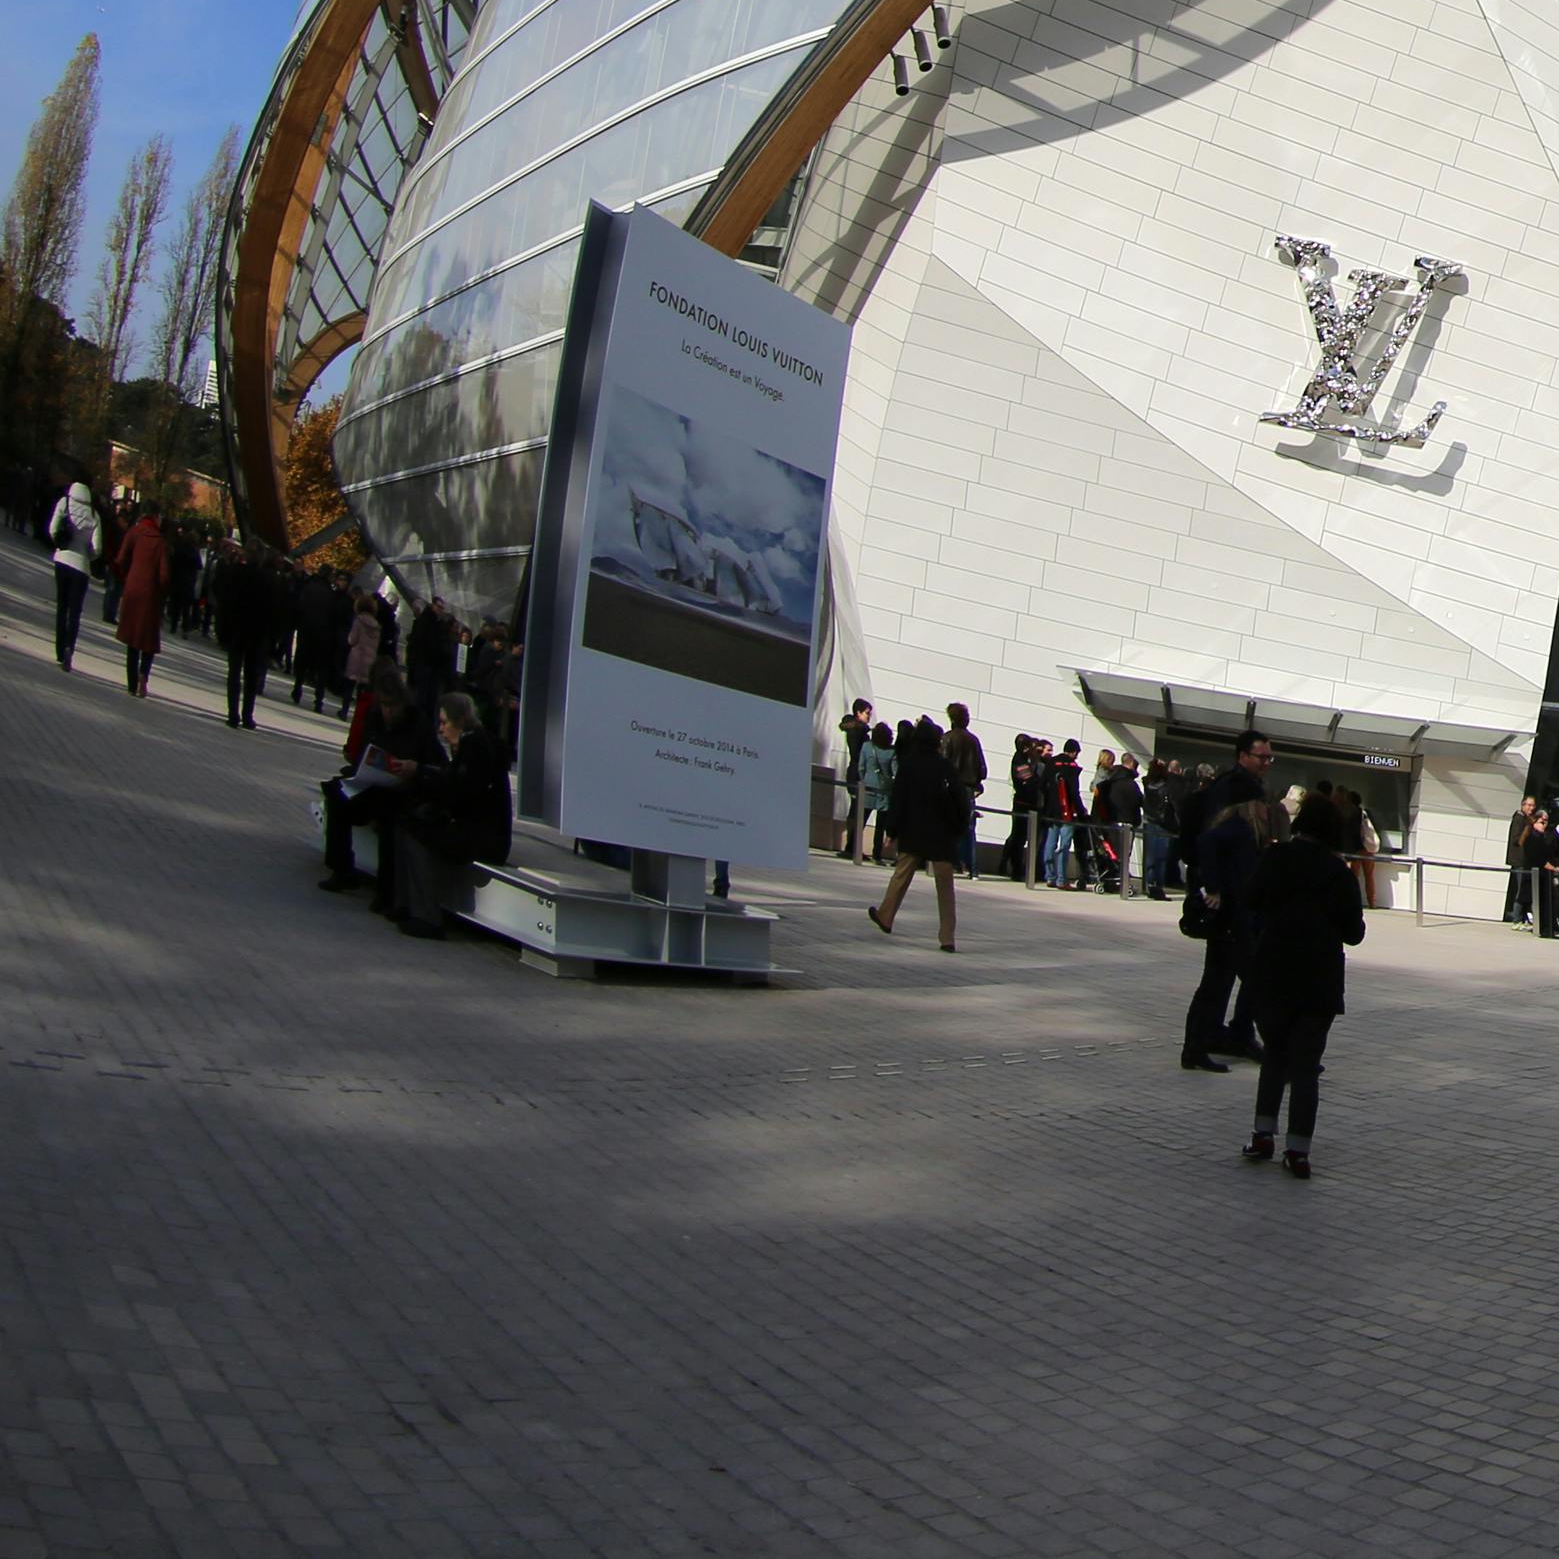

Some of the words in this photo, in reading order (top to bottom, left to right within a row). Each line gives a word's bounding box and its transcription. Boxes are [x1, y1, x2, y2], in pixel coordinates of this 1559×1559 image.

[649, 281, 728, 337] FONDATION
[732, 327, 769, 358] LOUIS
[773, 347, 824, 386] VUITTON
[681, 339, 691, 355] La
[694, 345, 728, 373] Création
[729, 366, 741, 379] est
[742, 376, 753, 385] un
[754, 375, 785, 402] Voyage.
[631, 721, 666, 737] Ouverture
[668, 729, 675, 740] le
[677, 731, 688, 742] 27
[689, 736, 715, 750] octobre
[717, 740, 735, 754] 2014
[694, 757, 712, 769] Frank
